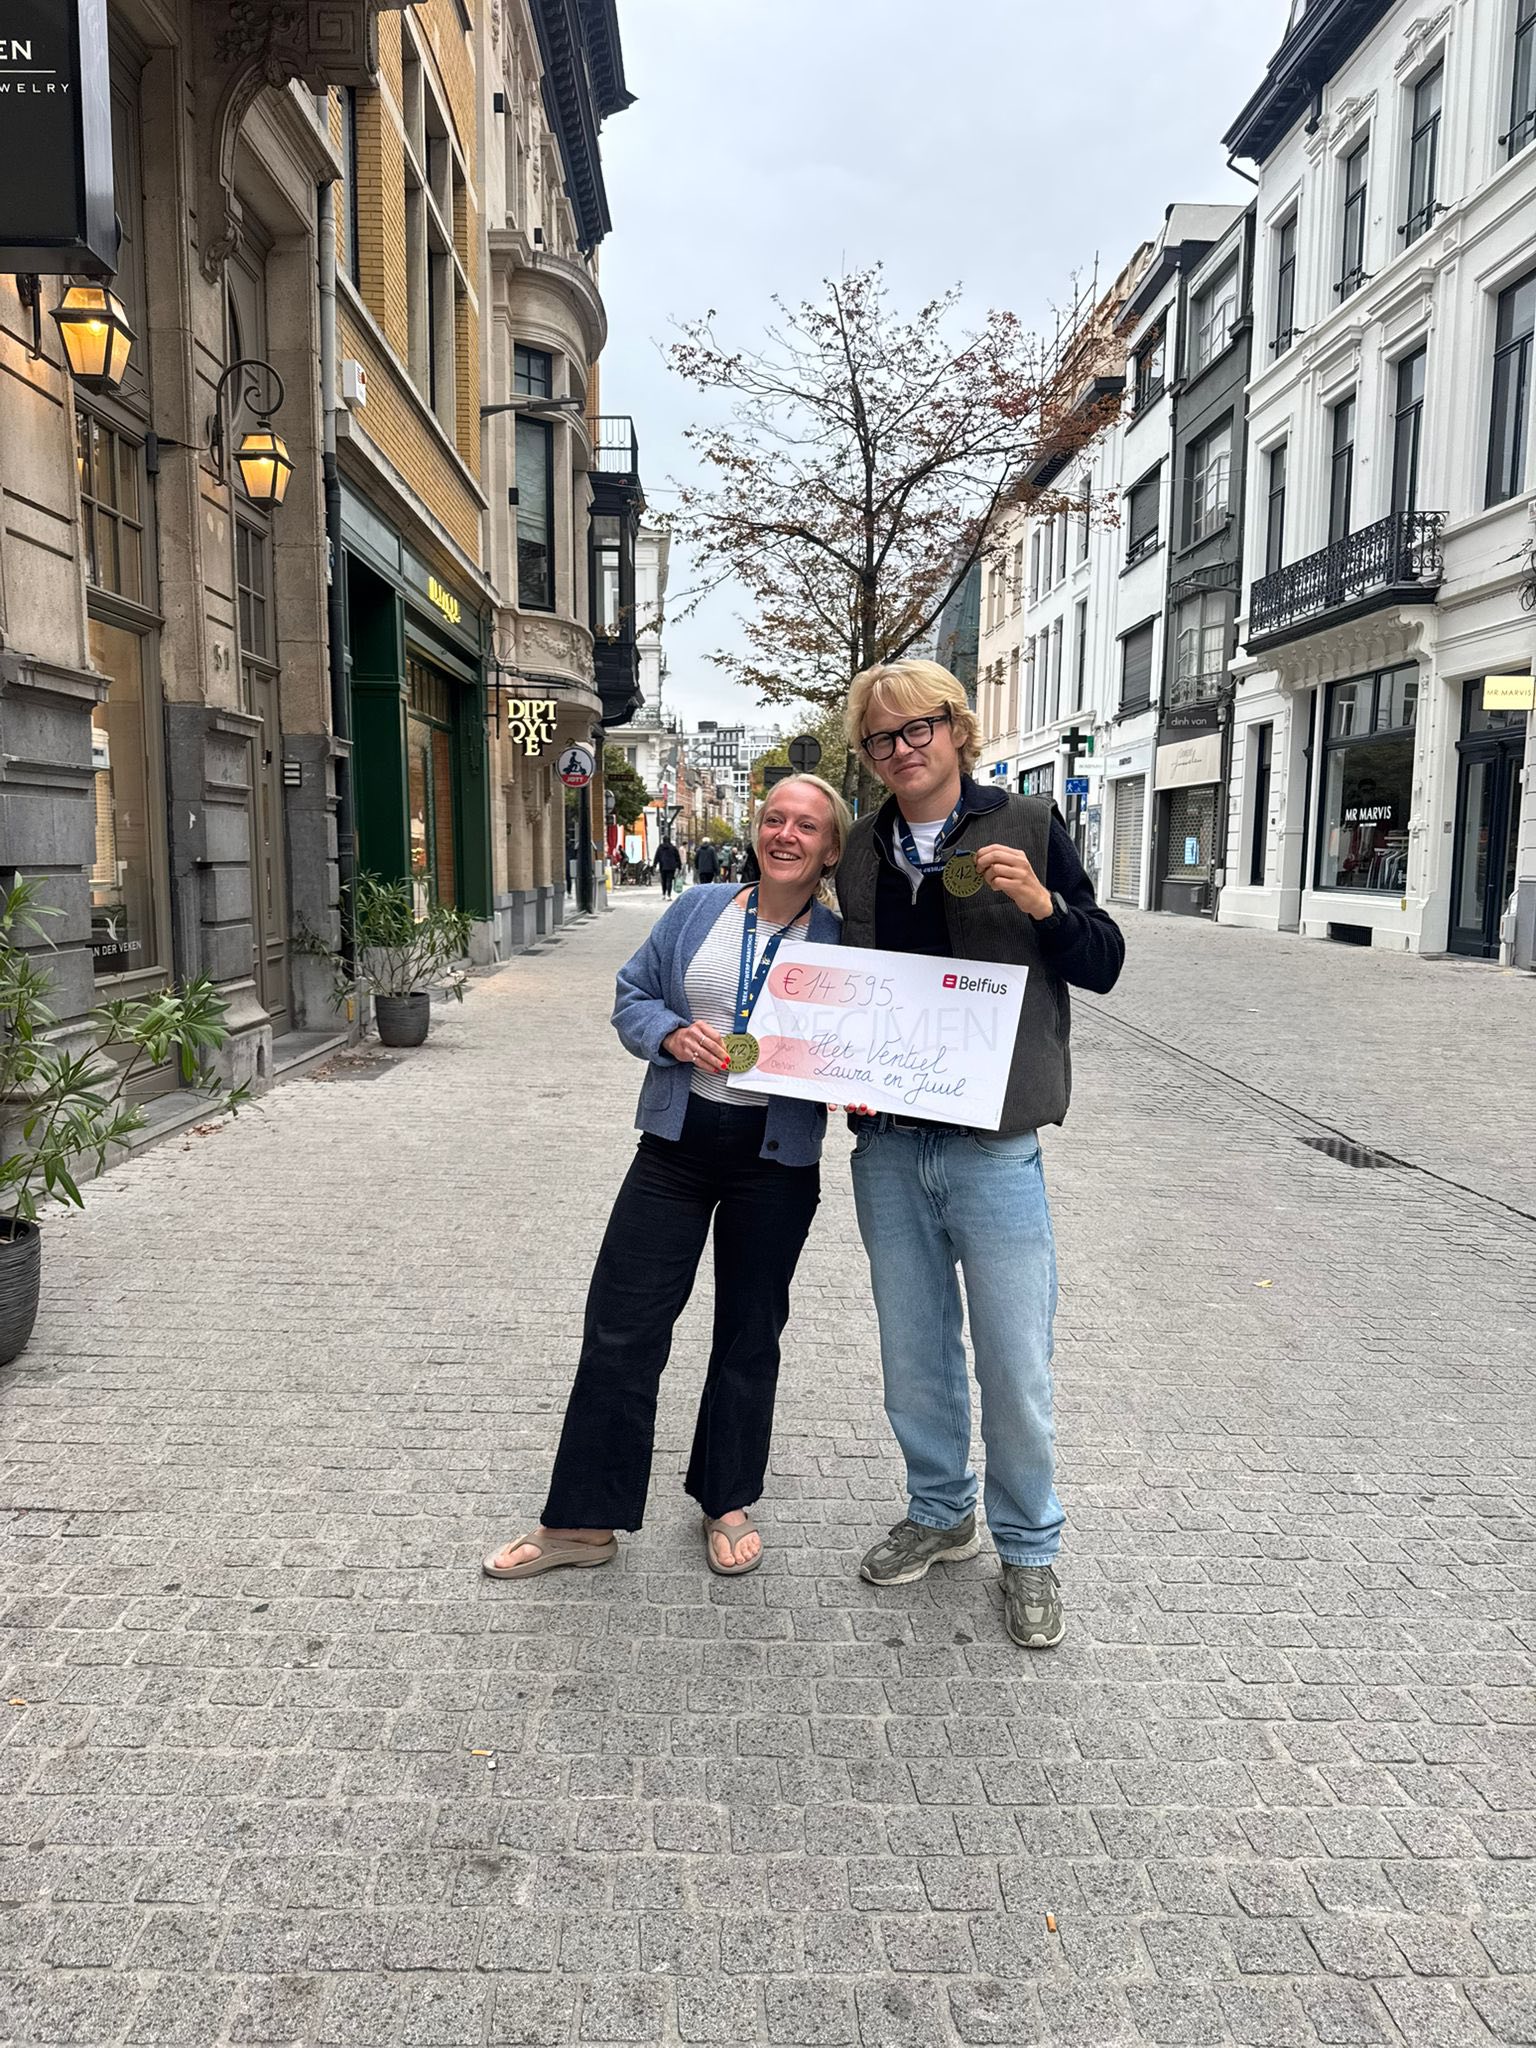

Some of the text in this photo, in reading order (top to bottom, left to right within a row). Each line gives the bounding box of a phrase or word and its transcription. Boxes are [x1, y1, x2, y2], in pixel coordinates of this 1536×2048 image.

[1171, 716, 1207, 726] dinh van
[1345, 805, 1392, 821] MR MARVIS
[955, 864, 973, 880] 42
[102, 944, 117, 956] DER
[119, 940, 141, 952] VEKEN
[743, 963, 751, 990] ANTWERP
[958, 975, 1008, 995] Belfius
[759, 1006, 998, 1054] SPECIMEN
[729, 1043, 747, 1057] 42
[808, 1032, 948, 1074] Het Ventiel
[813, 1058, 966, 1105] Laura en Juul
